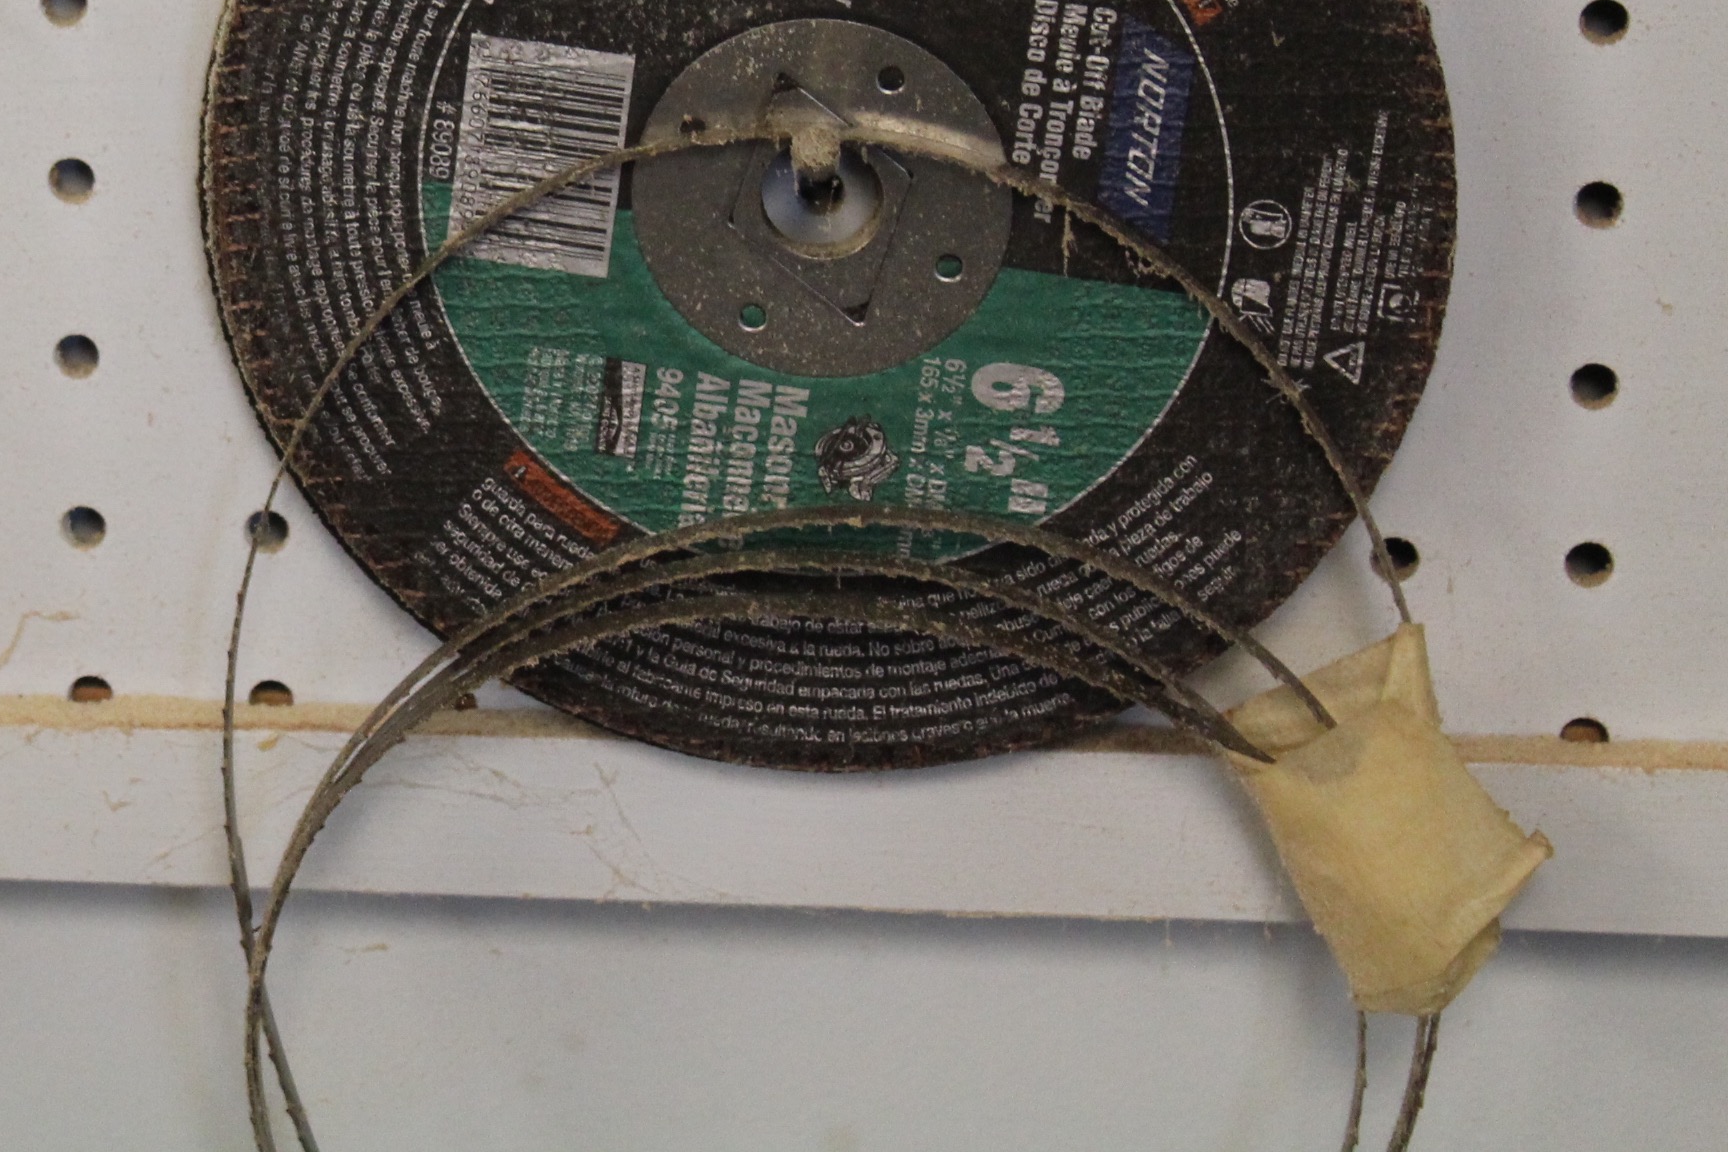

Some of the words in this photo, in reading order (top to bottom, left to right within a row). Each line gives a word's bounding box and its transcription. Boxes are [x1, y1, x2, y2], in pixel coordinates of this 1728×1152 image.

[1051, 2, 1087, 75] Meule
[1081, 7, 1118, 92] Cut-Off
[435, 100, 456, 113] #
[1019, 68, 1047, 96] de
[1051, 78, 1077, 93] à
[427, 118, 455, 179] 89089
[1011, 102, 1042, 165] Corte
[1071, 95, 1103, 160] Blade
[1122, 49, 1170, 206] NORTON
[919, 357, 941, 388] 165
[760, 385, 809, 509] Masonr
[909, 407, 934, 453] 3mm
[482, 476, 527, 517] guarda
[524, 513, 556, 539] para
[1107, 522, 1120, 535] y
[1118, 476, 1176, 528] protegida
[1172, 455, 1197, 478] con
[1118, 522, 1154, 552] pieza
[1153, 508, 1172, 525] de
[1171, 470, 1213, 512] trabajo
